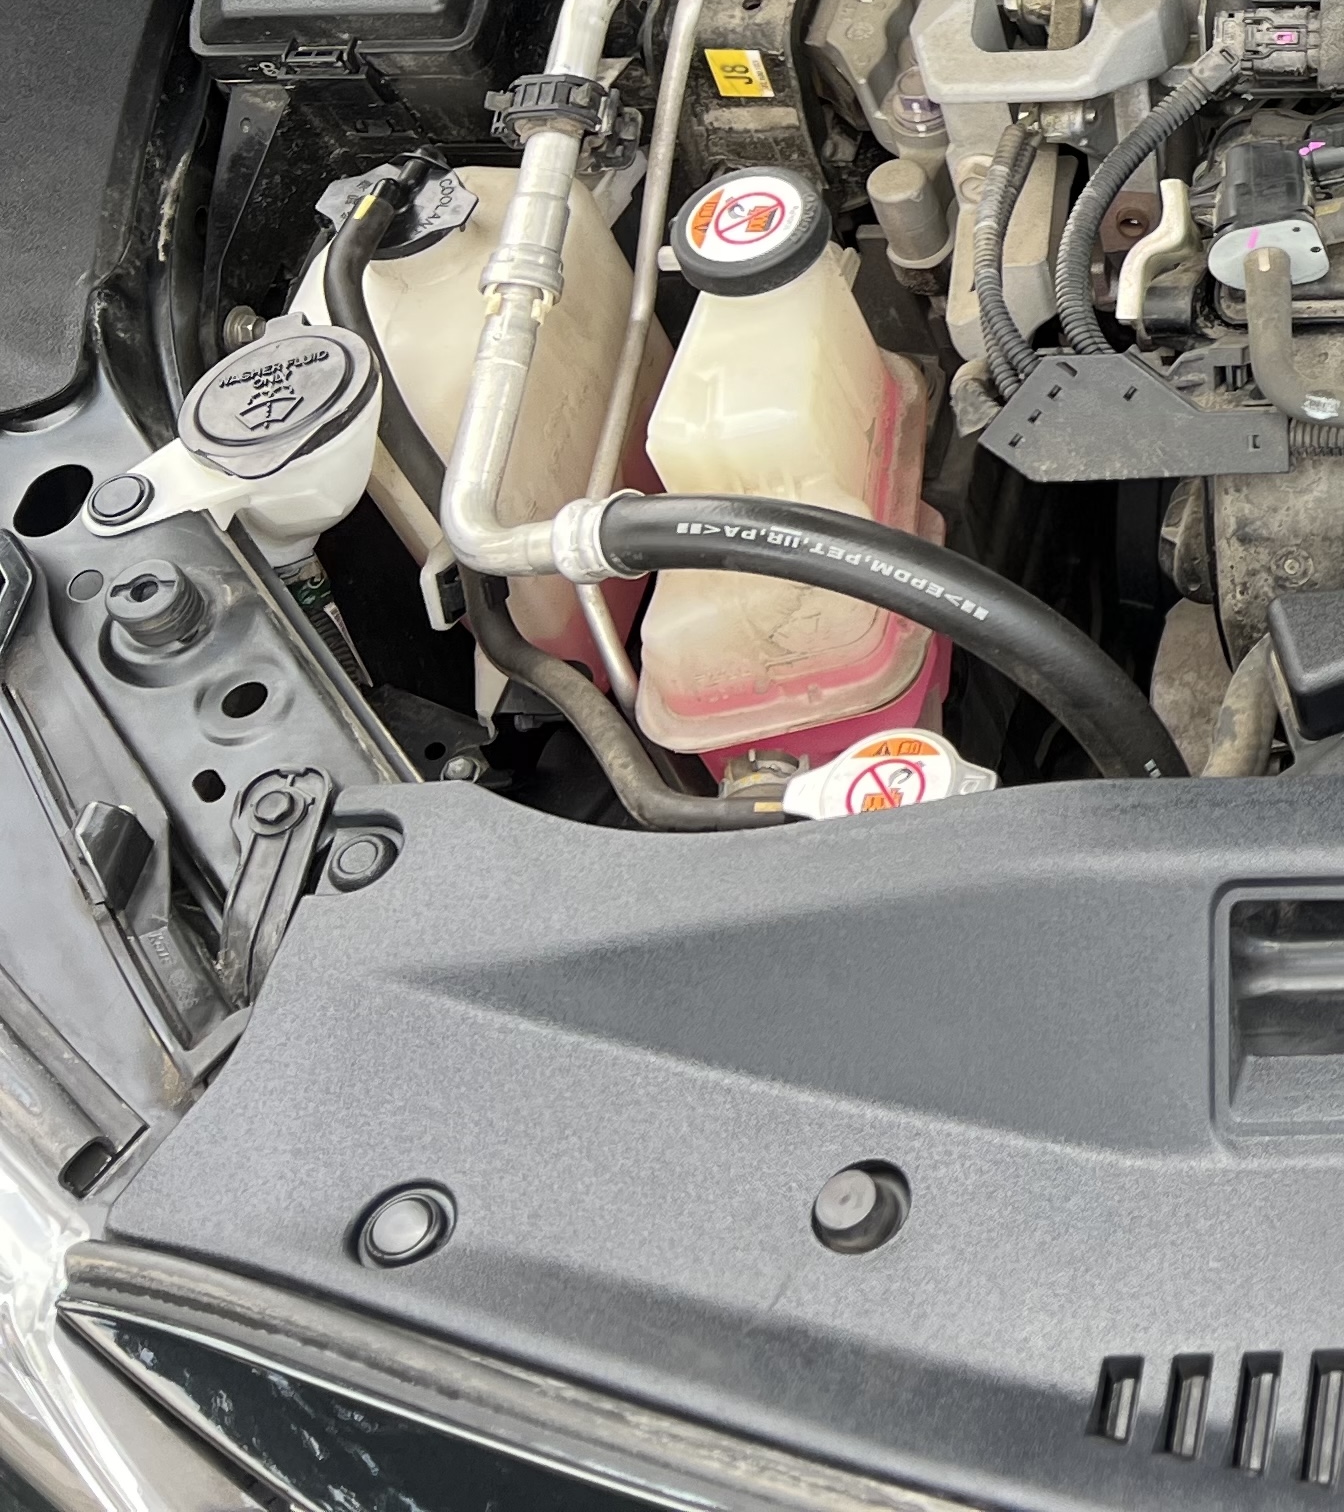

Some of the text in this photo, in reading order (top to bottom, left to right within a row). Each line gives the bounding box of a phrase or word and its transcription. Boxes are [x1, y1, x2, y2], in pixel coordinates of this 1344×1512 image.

[721, 64, 753, 85] J8
[219, 350, 330, 388] WASHER FLUID
[253, 371, 293, 389] ONLY
